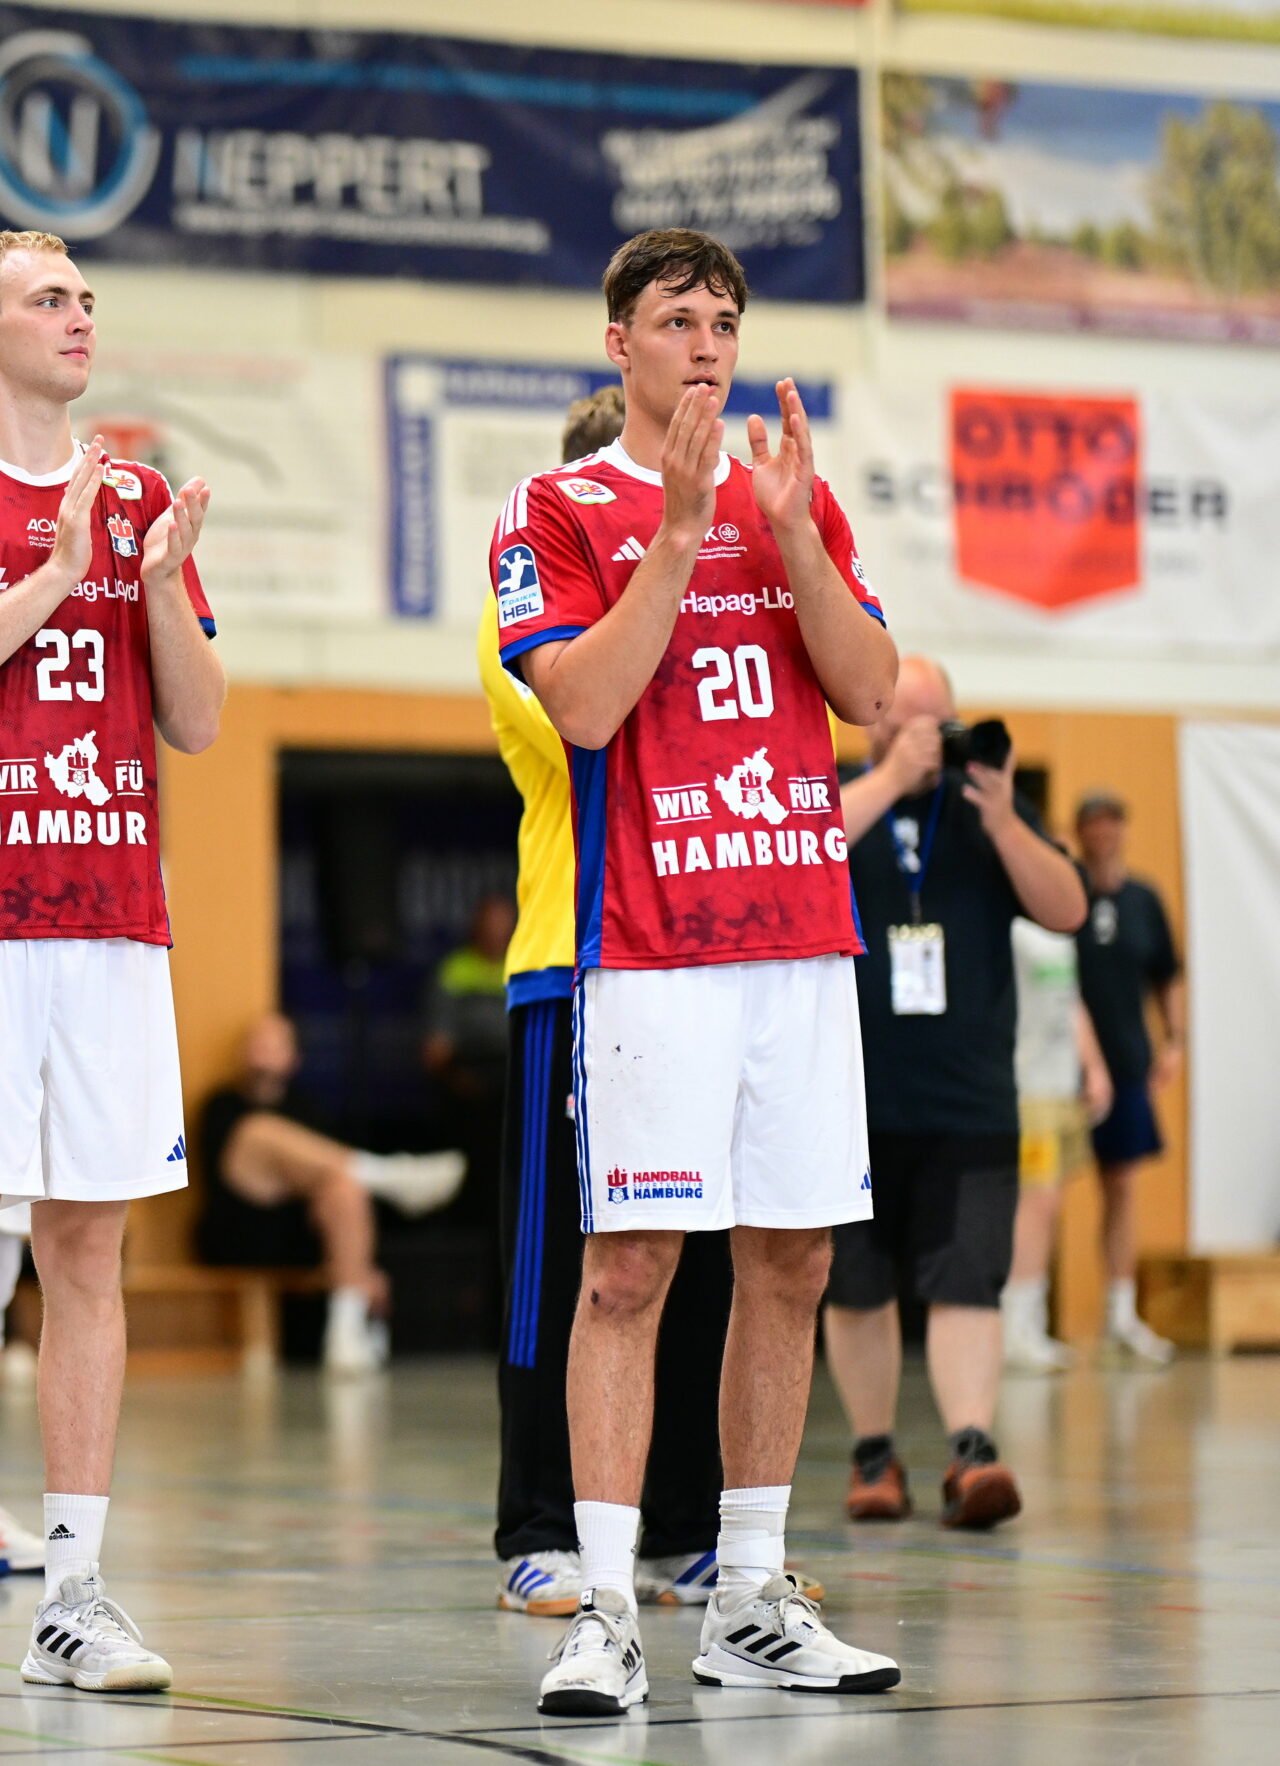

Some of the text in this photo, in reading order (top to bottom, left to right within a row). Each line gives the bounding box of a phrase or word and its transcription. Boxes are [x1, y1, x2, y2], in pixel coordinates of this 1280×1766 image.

[955, 406, 1134, 462] OTTO
[503, 601, 540, 622] HBL
[508, 592, 537, 605] DAIKIN
[680, 586, 796, 617] Hapag-Llo
[36, 628, 105, 702] 23
[692, 644, 775, 722] 20
[115, 760, 144, 791] FÜ
[652, 777, 832, 820] WIR FÜR
[651, 826, 849, 877] HAMBURG
[632, 1171, 704, 1184] HANDBALL
[632, 1188, 704, 1200] HAMBURG
